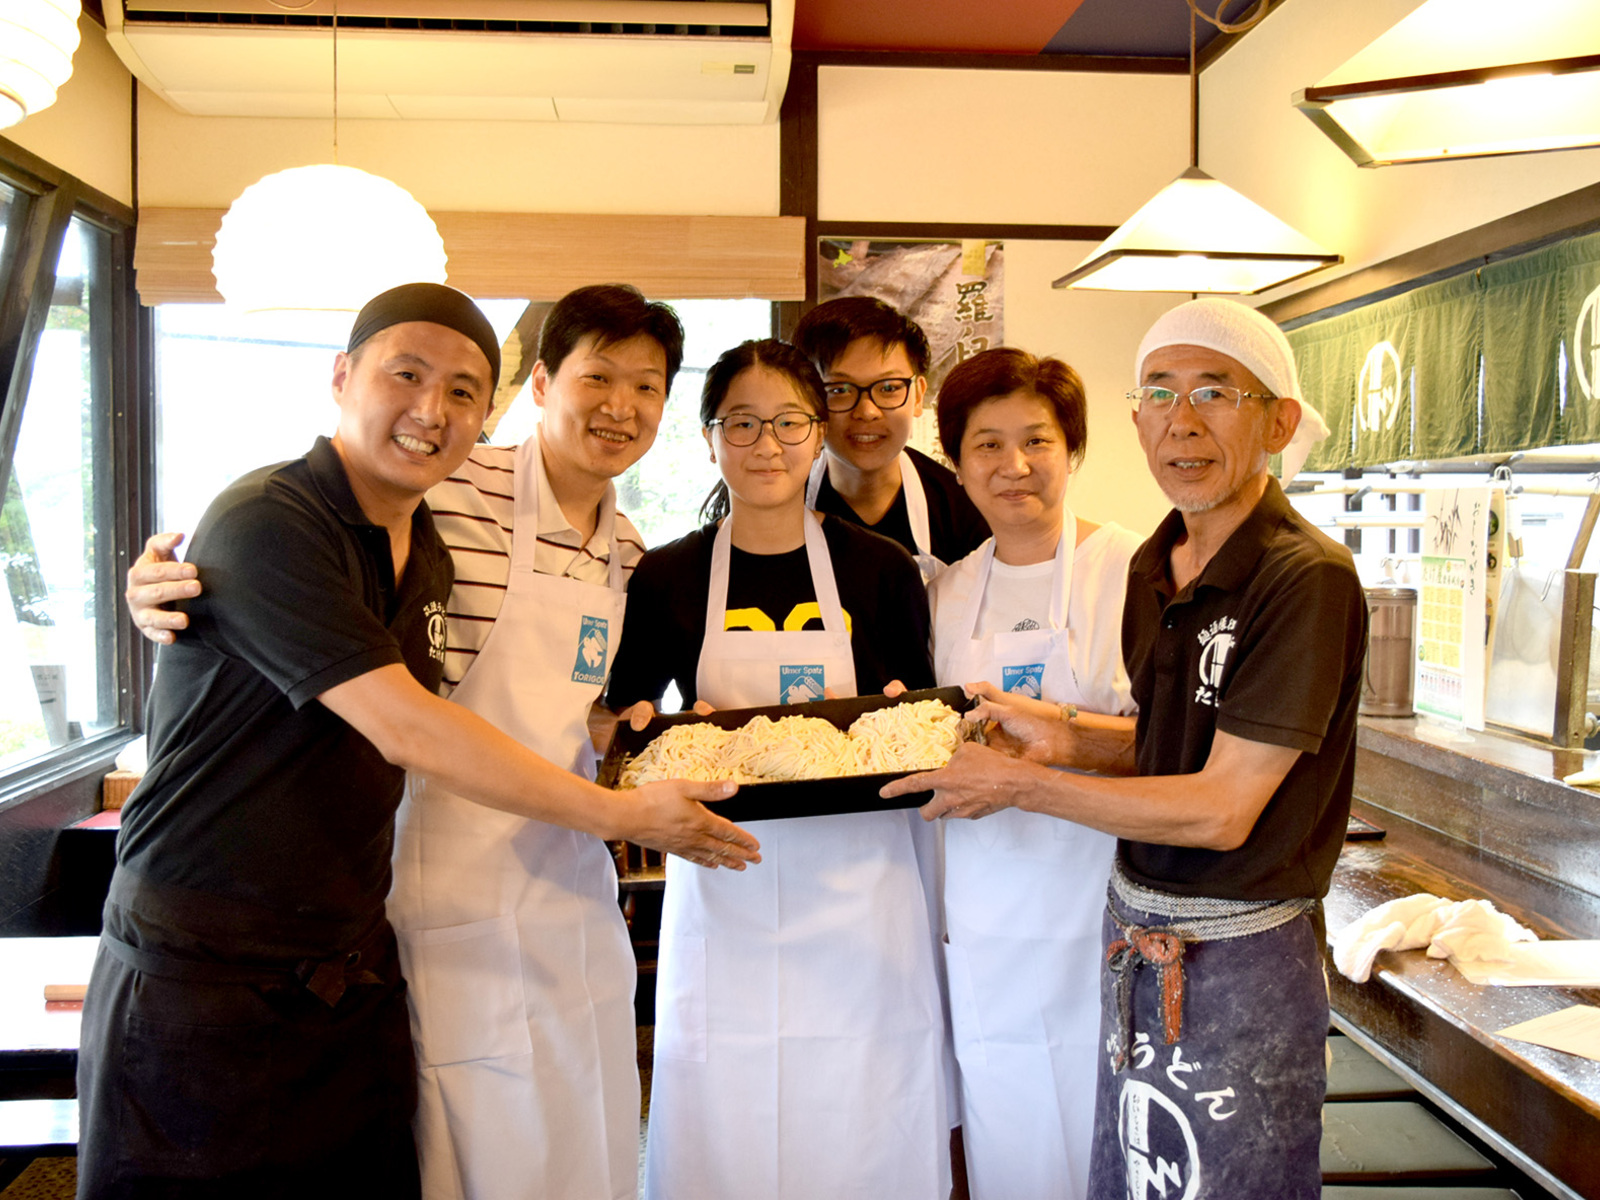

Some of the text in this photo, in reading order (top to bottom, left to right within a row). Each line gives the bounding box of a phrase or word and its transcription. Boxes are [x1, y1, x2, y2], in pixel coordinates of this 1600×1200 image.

[782, 667, 823, 675] Ulmer Spatz
[1004, 666, 1043, 676] Ulmer Spatz
